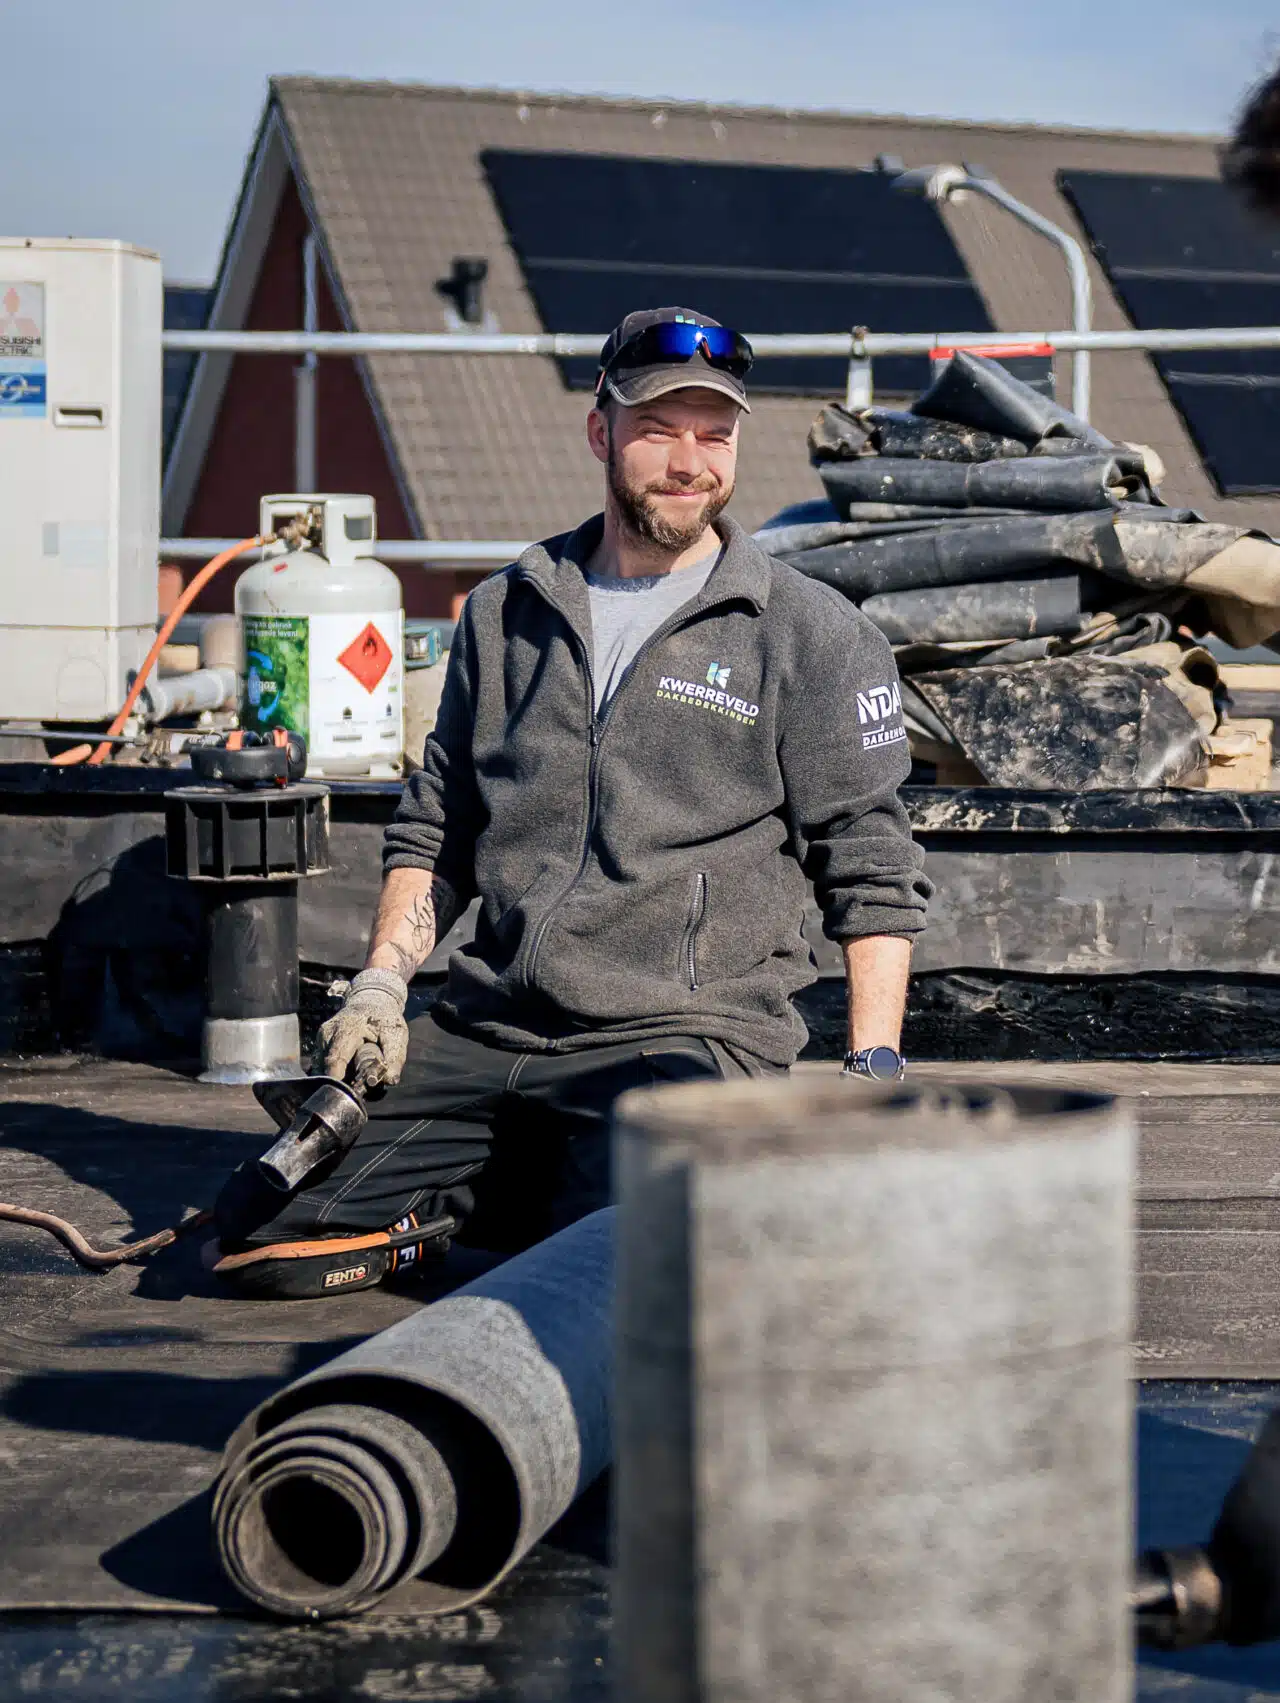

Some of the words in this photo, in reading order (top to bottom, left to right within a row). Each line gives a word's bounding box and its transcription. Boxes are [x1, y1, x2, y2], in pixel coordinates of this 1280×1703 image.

[0, 335, 41, 345] SUBISHI
[656, 689, 756, 726] DAKBEDEKKINGEN
[658, 676, 760, 717] KWERREVELD
[856, 681, 902, 724] NDA
[325, 1266, 366, 1285] FENTO
